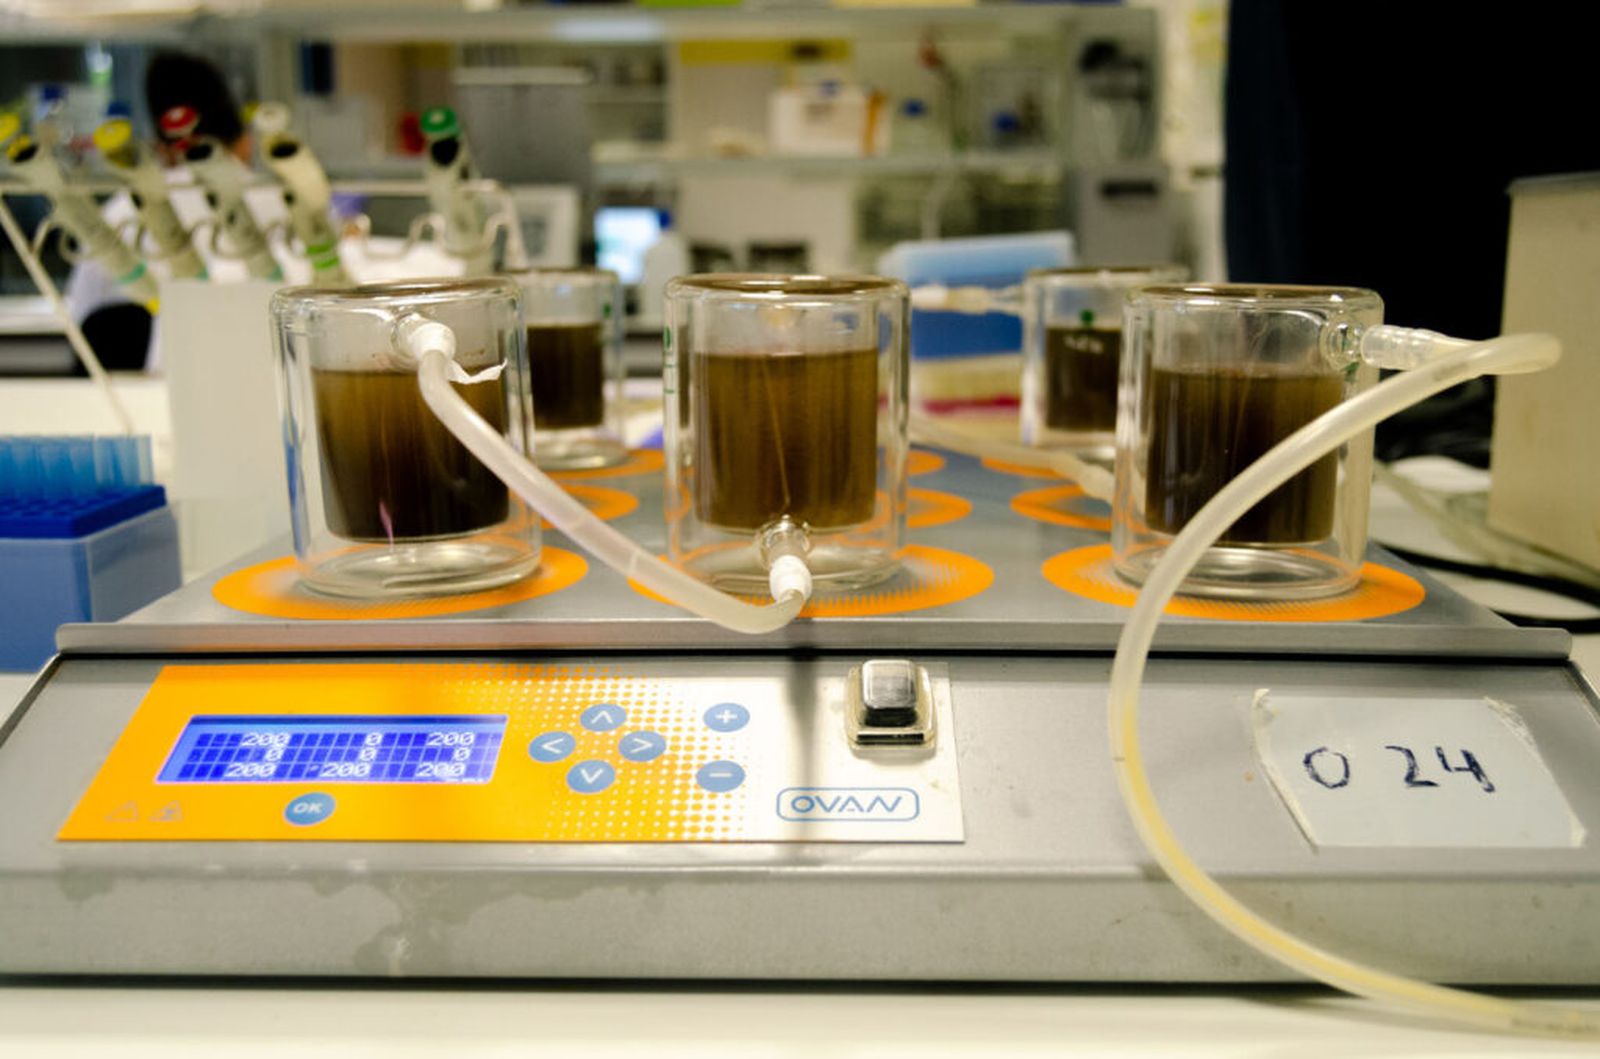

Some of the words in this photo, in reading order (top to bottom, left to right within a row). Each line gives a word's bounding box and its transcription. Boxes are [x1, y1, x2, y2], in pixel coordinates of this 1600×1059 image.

[241, 732, 291, 747] 200
[426, 732, 475, 746] 200
[224, 762, 277, 777] 200
[415, 762, 465, 777] 200
[1384, 745, 1496, 793] 24
[293, 801, 324, 814] OK
[791, 795, 904, 813] OVAN
